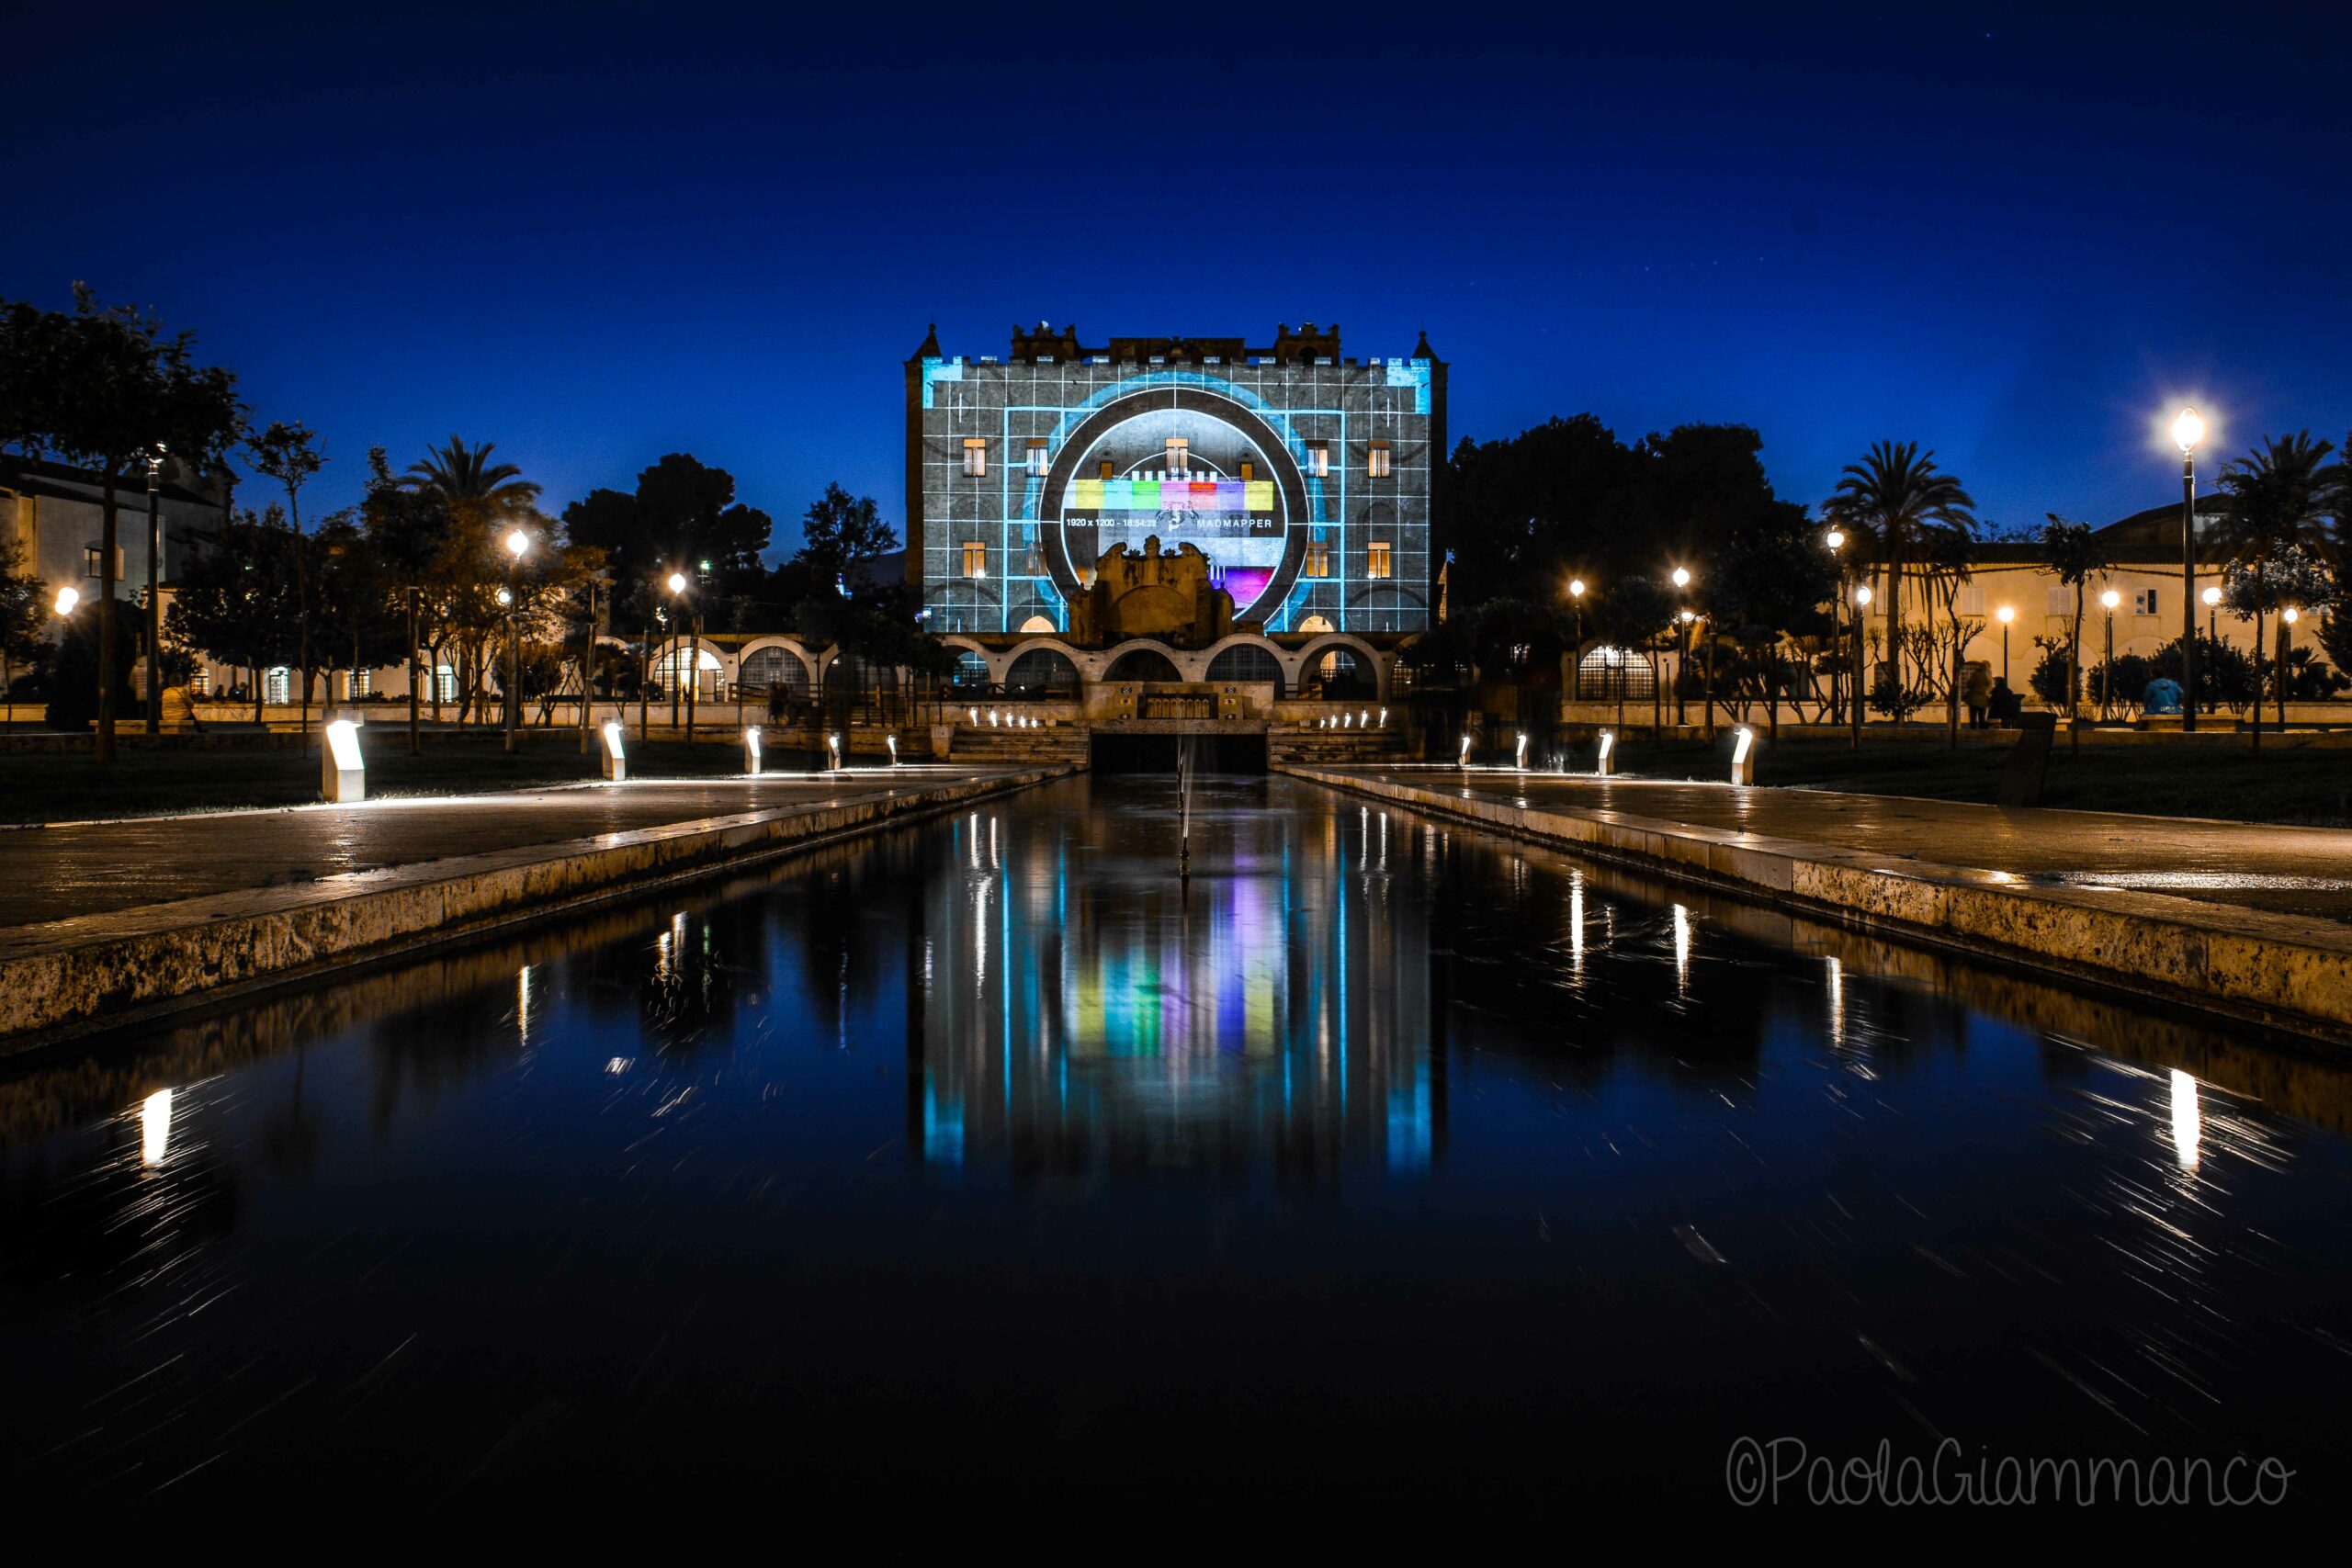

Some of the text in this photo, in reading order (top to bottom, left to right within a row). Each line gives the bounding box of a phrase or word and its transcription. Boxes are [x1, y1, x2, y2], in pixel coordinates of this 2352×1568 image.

[1067, 518, 1086, 527] 1920
[1095, 518, 1114, 527] 1200
[1196, 519, 1272, 528] MADMAPPER
